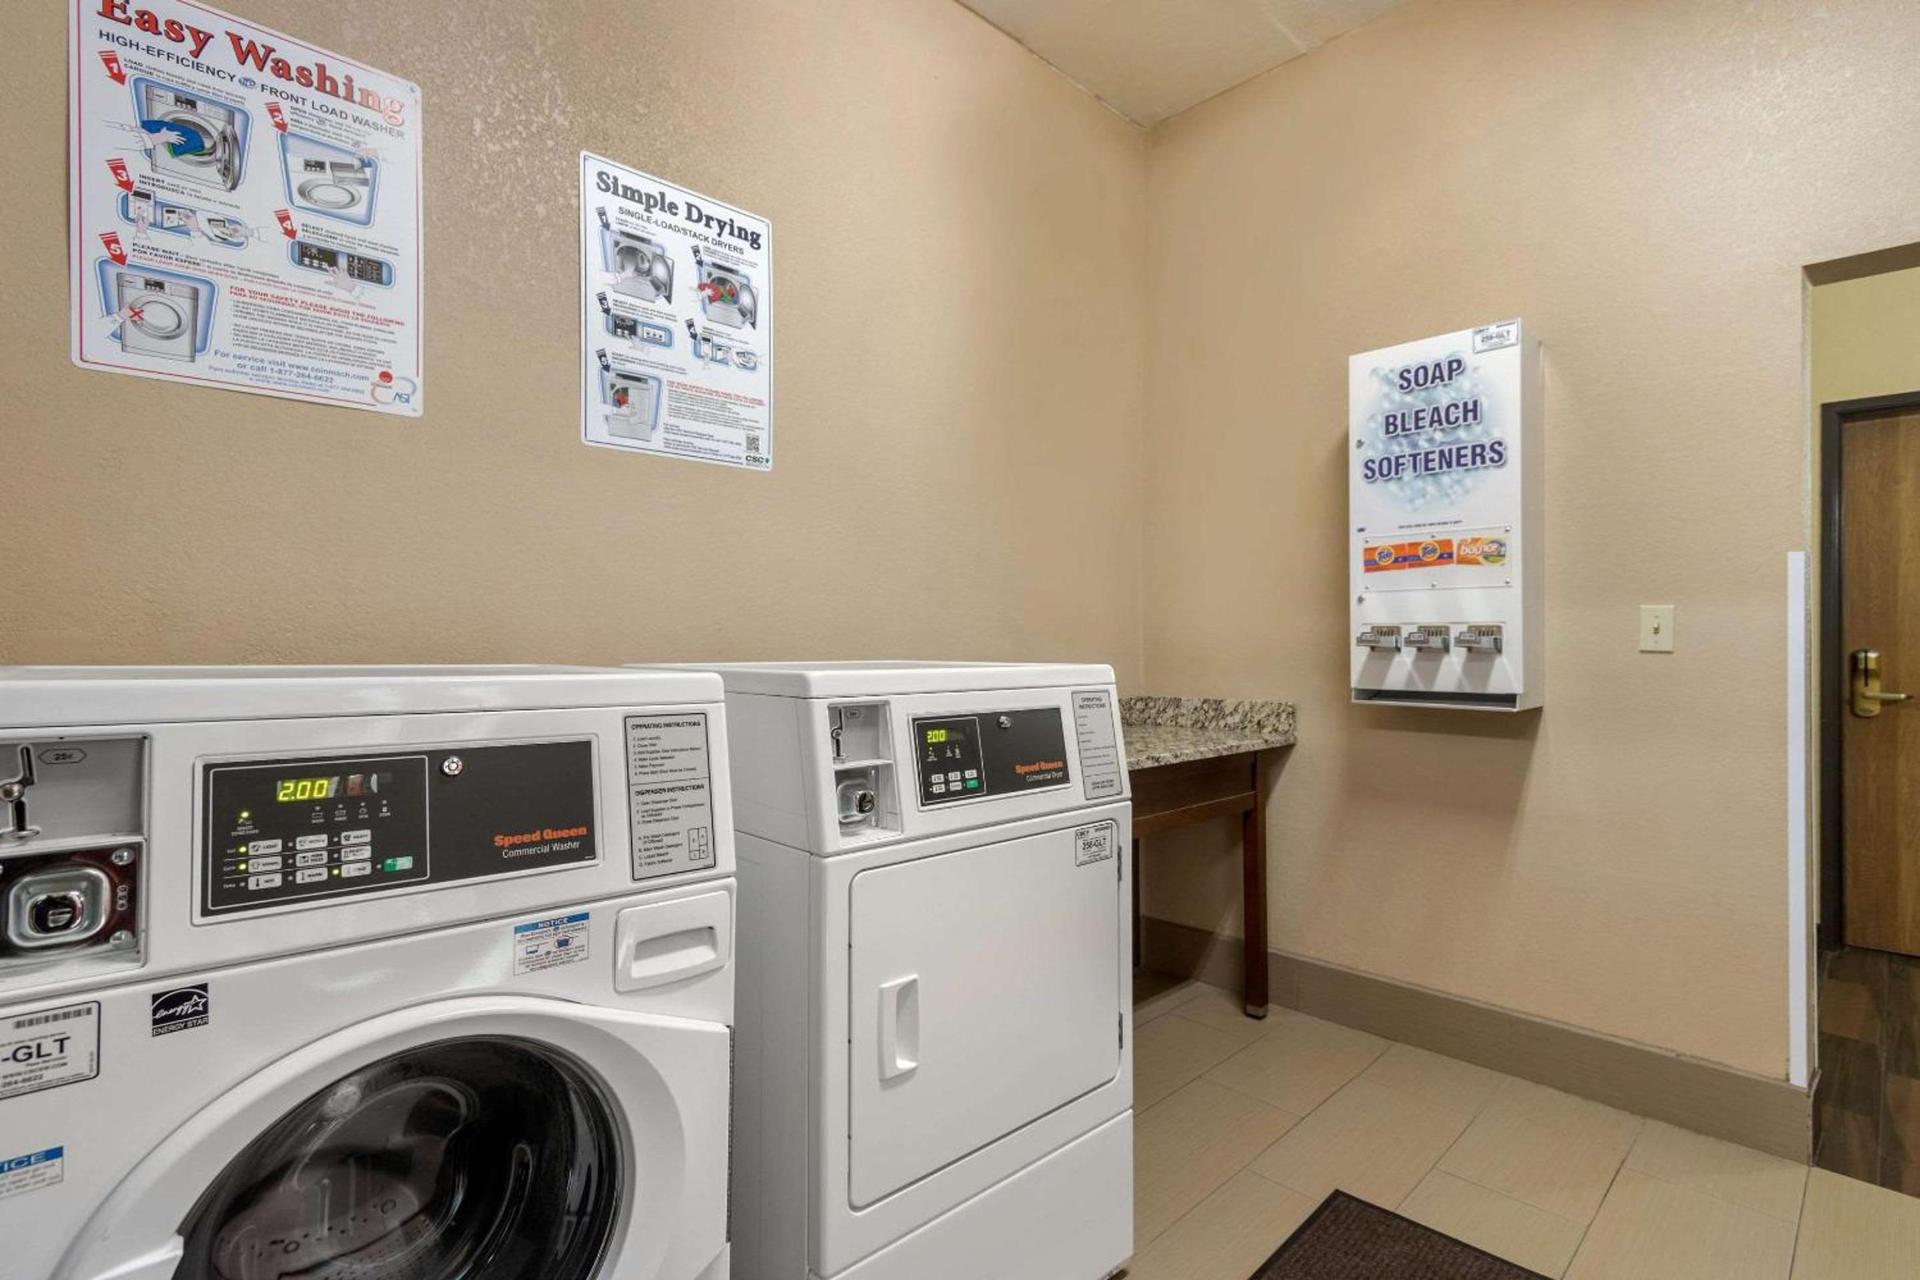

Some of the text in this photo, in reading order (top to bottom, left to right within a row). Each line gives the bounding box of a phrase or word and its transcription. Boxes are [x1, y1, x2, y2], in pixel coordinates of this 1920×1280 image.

[97, 0, 214, 57] Easy
[225, 31, 405, 126] Washing
[99, 29, 237, 83] HIGH-EFFICIENCY
[261, 84, 308, 107] FRONT
[311, 100, 348, 120] LOAD
[352, 114, 405, 140] WASHER
[596, 170, 680, 215] Simple
[684, 201, 762, 250] Drying
[711, 238, 745, 256] DRYERS
[213, 349, 230, 359] For
[232, 354, 265, 366] service
[267, 357, 286, 368] visit
[236, 362, 247, 370] or
[249, 363, 267, 373] call
[1398, 358, 1464, 392] SOAP
[1384, 399, 1479, 436] BLEACH
[745, 454, 764, 464] CSC
[1363, 440, 1504, 481] SOFTENERS
[1015, 762, 1039, 775] Speed
[278, 779, 329, 801] 2.00
[494, 826, 588, 847] Speed Queen
[502, 841, 580, 858] Commercial Washer
[538, 917, 568, 928] NOTICE
[153, 1017, 209, 1037] ENERGY STAR
[1, 1035, 72, 1063] -GLT
[4, 1151, 47, 1172] ICE
